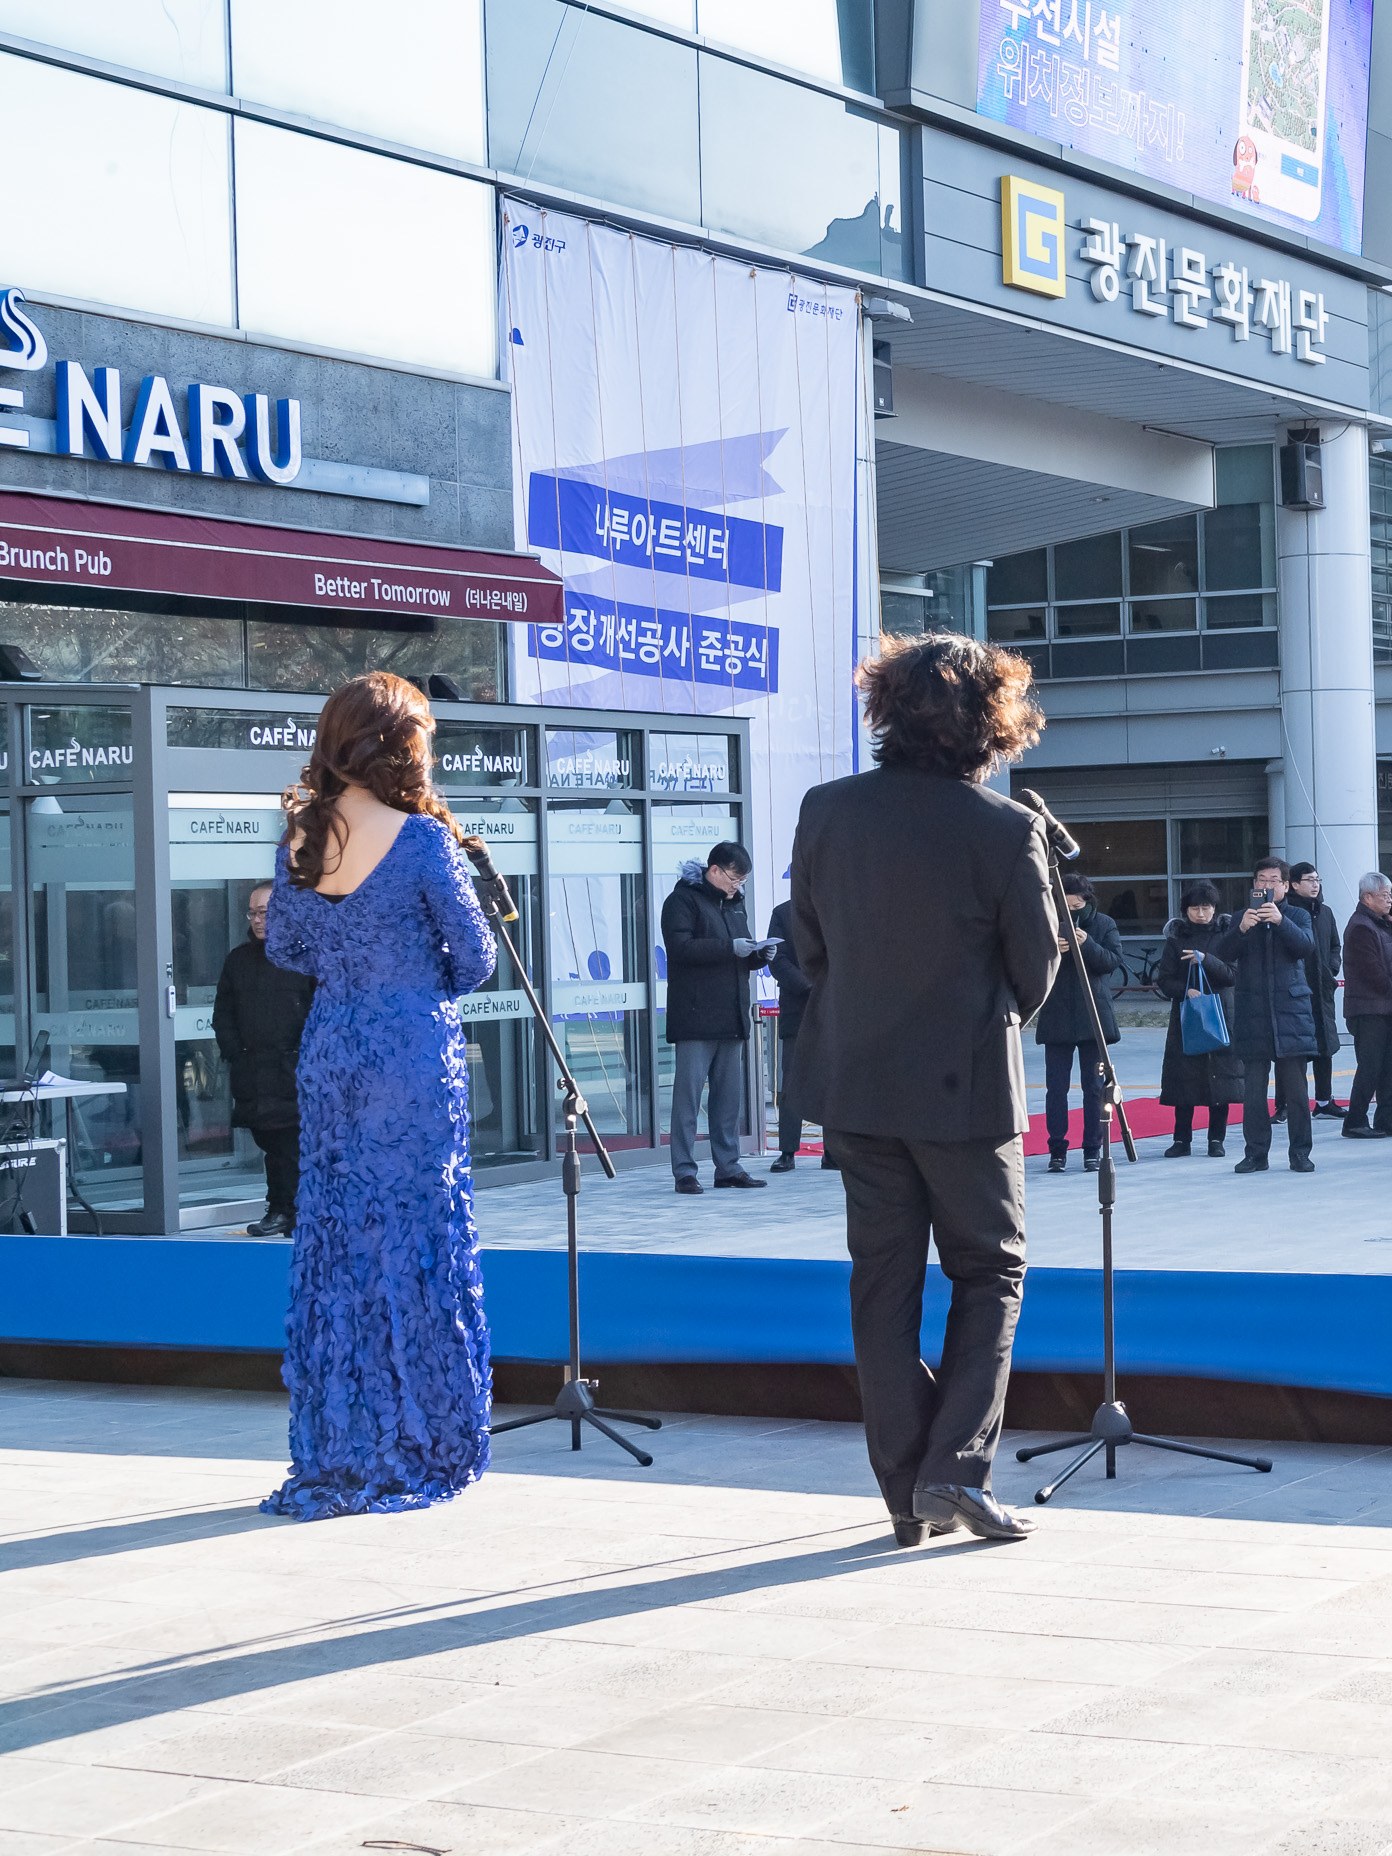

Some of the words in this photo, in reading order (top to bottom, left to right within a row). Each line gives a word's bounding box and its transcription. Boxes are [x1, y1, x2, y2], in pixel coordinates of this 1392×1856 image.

[997, 37, 1186, 162] 위치정보까지!
[531, 233, 566, 254] 광진구
[1079, 217, 1330, 366] 광진문화재단
[799, 299, 843, 321] 광진문화재단
[56, 360, 302, 484] NARU
[596, 503, 730, 570] 나루아트센터
[0, 540, 70, 572] Brunch
[74, 548, 112, 576] Pub
[314, 573, 368, 599] Better
[371, 578, 451, 607] Tomorrow
[465, 587, 528, 613] (더나은내일)
[699, 630, 769, 678] 준공식
[82, 746, 133, 766] NARU
[483, 755, 522, 773] NARU
[594, 759, 630, 776] NARU
[693, 763, 726, 780] NARU
[227, 821, 260, 834] NARU
[486, 823, 515, 835] NARU
[492, 1000, 520, 1013] NARU
